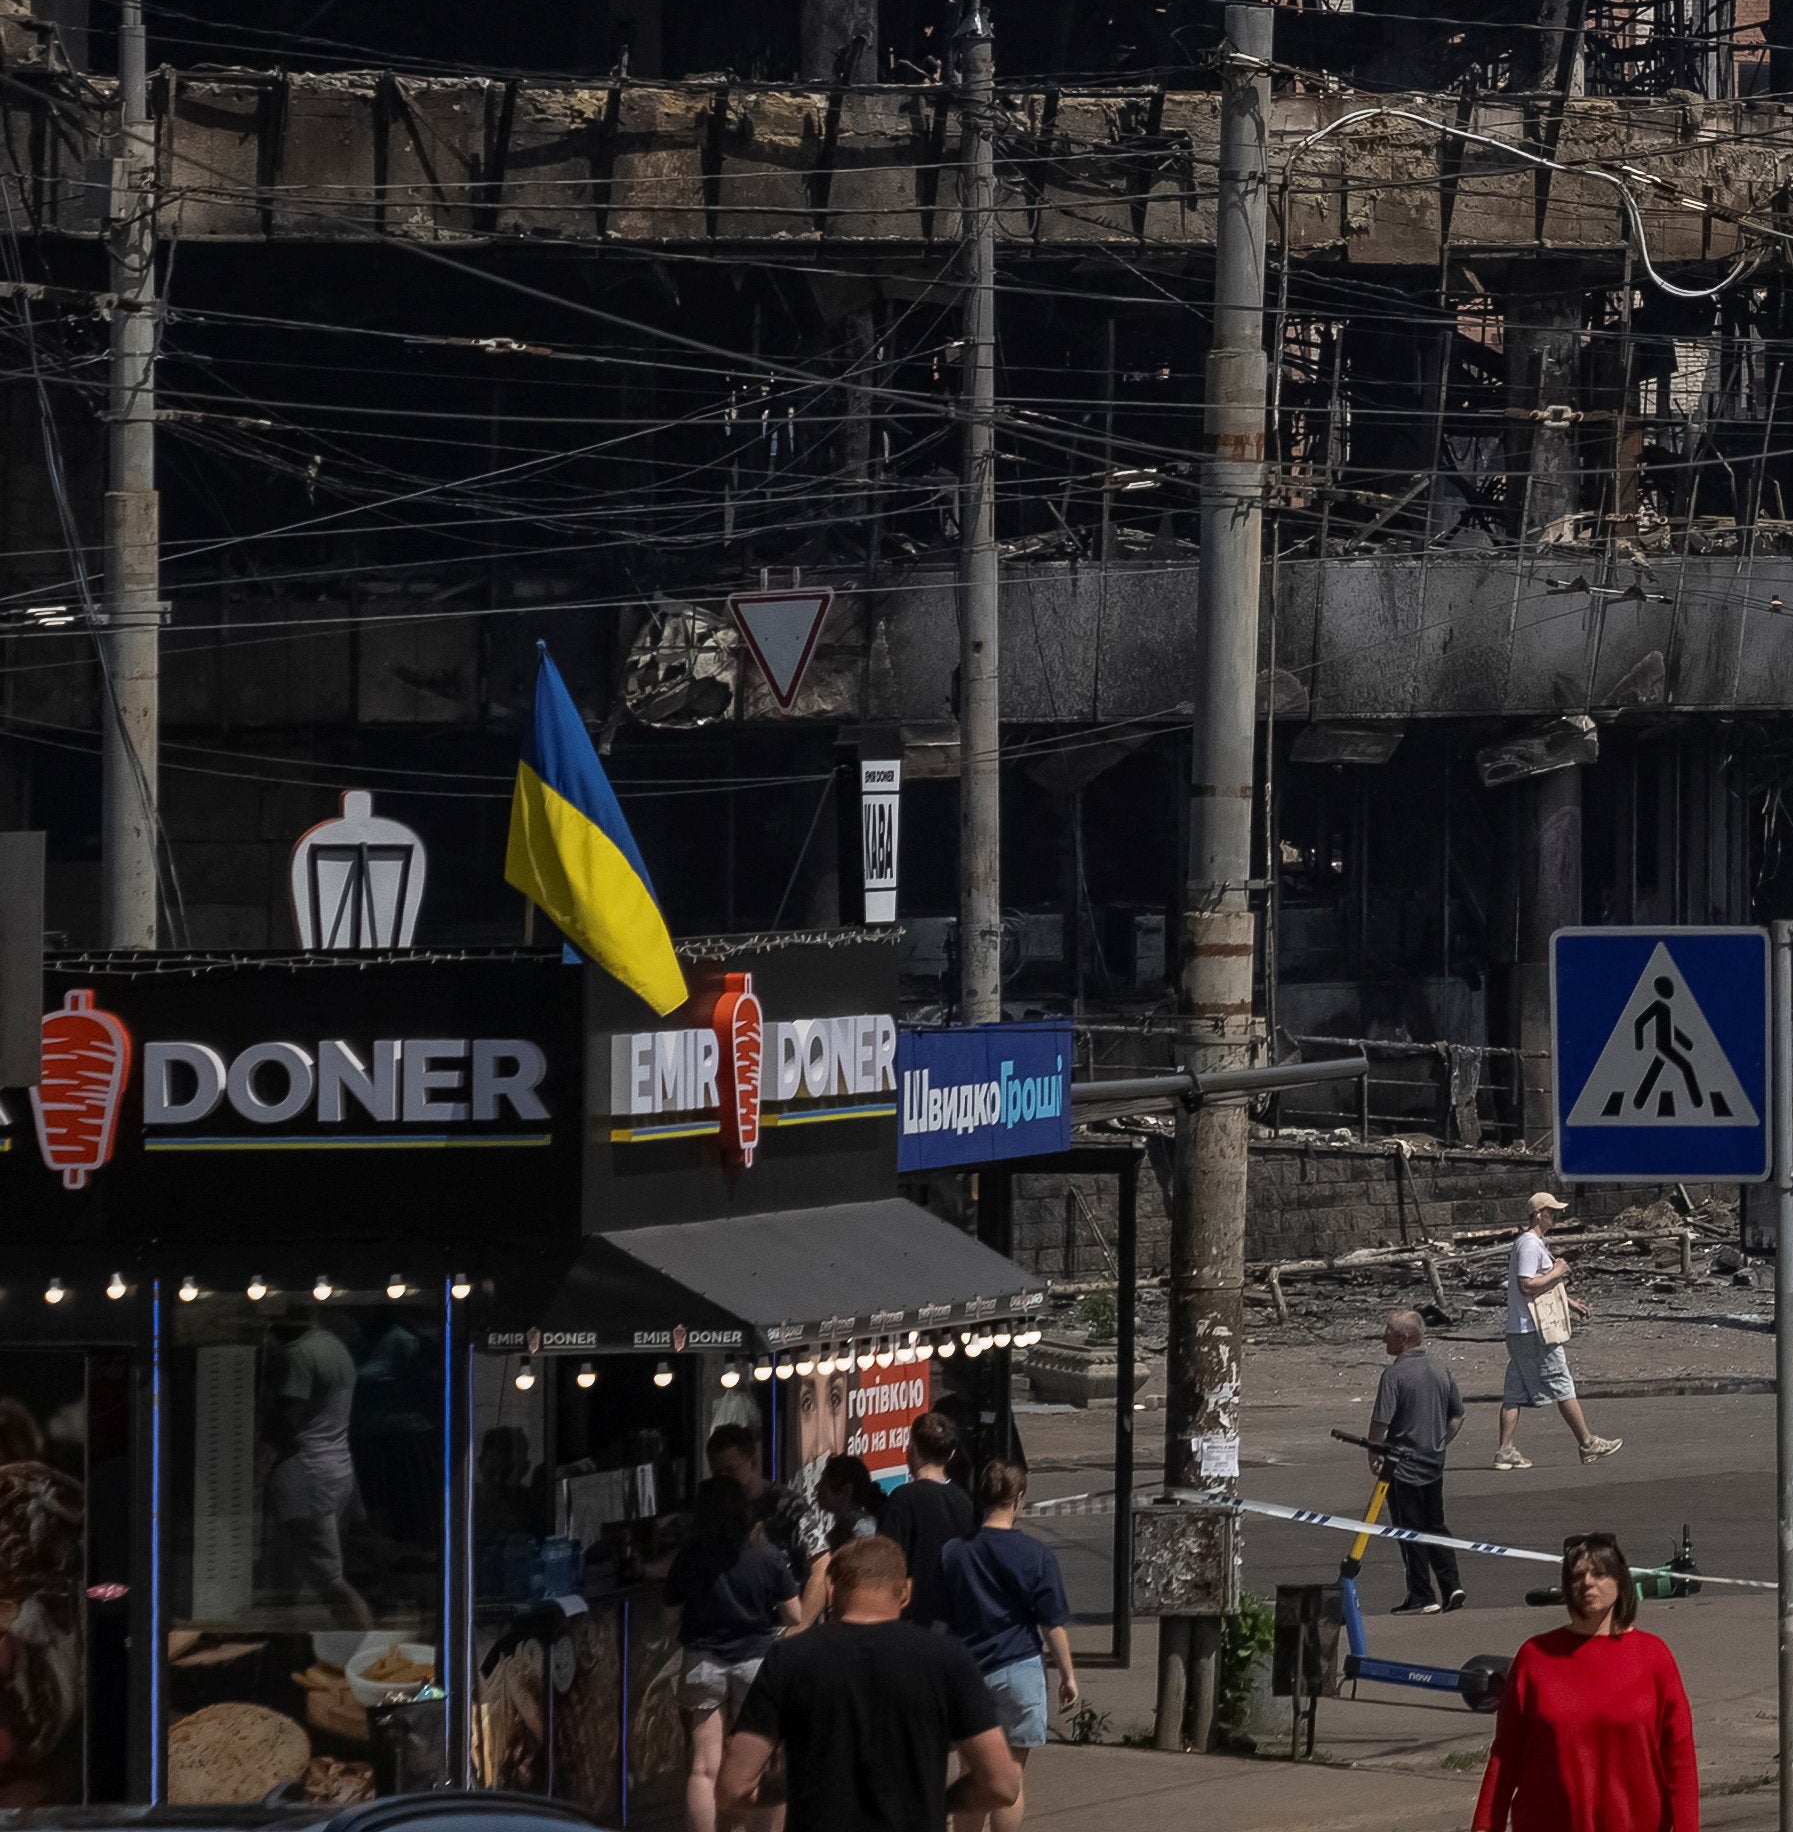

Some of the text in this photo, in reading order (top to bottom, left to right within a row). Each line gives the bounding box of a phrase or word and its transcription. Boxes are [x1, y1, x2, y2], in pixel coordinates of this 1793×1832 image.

[864, 803, 894, 880] КАВА
[144, 1038, 551, 1125] DONER
[626, 1013, 897, 1114] EMIR DONER
[903, 1055, 1063, 1136] ШвидкоГроші
[487, 1332, 597, 1345] EMIR DONER
[633, 1330, 743, 1345] EMIR DONER
[848, 1425, 912, 1456] або на кар
